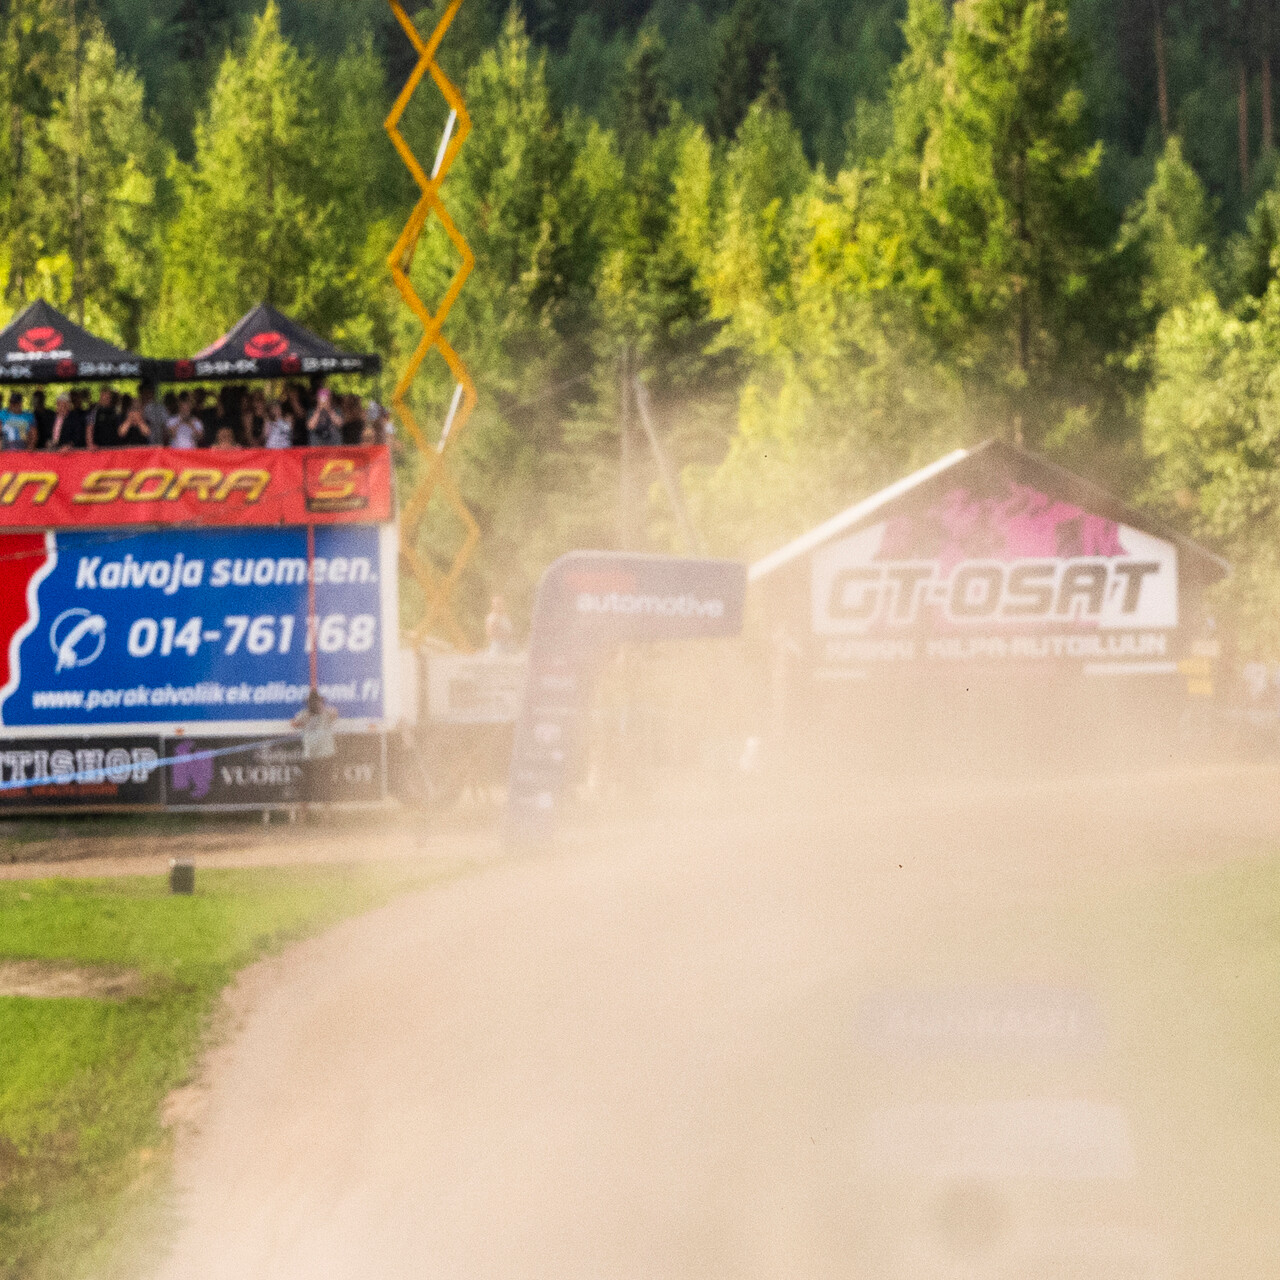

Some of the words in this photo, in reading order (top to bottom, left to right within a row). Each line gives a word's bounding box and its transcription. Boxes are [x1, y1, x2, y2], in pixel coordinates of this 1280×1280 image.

[73, 468, 271, 503] SORA
[76, 553, 203, 595] Kaivoja
[210, 555, 379, 588] suomeen.
[824, 560, 1162, 620] GT-OSAT
[128, 615, 294, 657] 014-761
[0, 748, 158, 786] TISHOP
